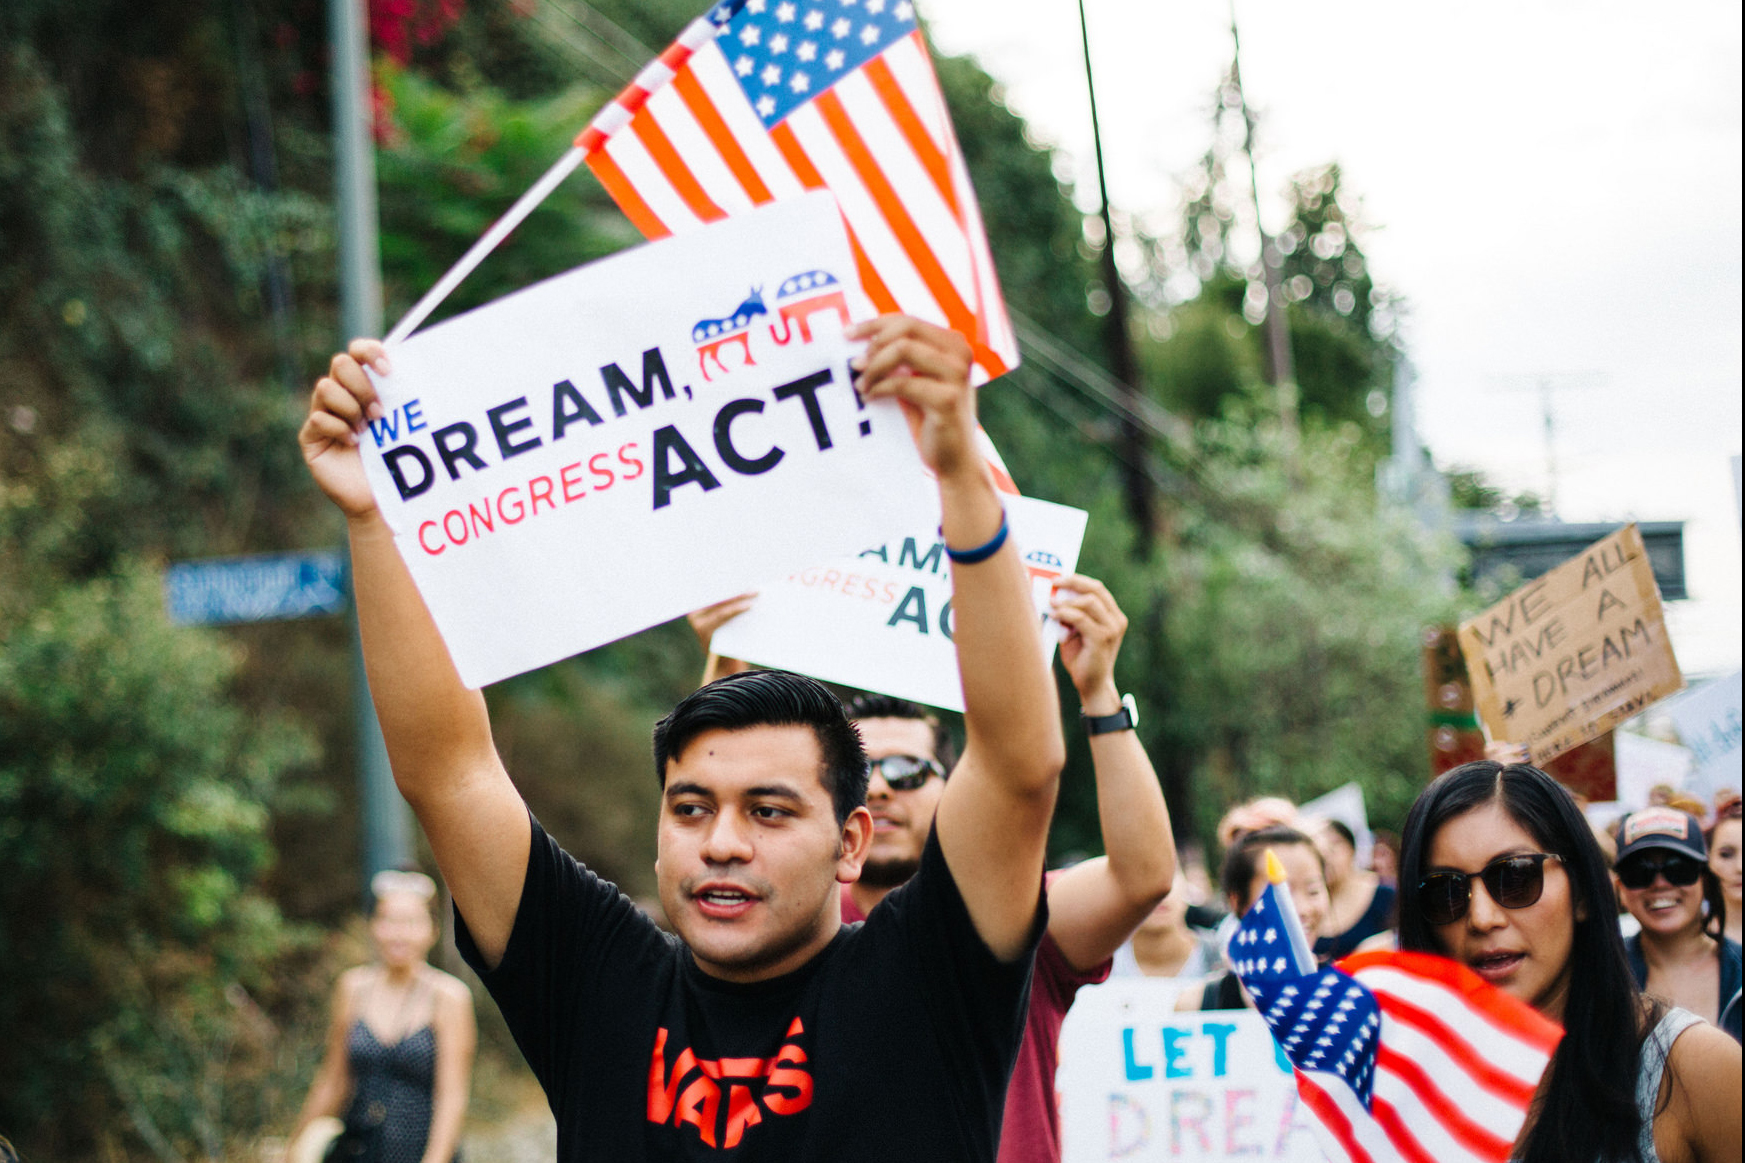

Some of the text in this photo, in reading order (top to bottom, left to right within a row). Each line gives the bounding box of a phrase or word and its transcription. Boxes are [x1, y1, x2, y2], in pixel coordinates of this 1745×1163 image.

[368, 400, 428, 447] WE
[381, 347, 693, 502] DREAM,
[418, 442, 645, 556] CONGRESS
[1473, 543, 1639, 648] WE ALL
[1483, 588, 1627, 686] HAVE A
[1532, 617, 1652, 709] DREAM
[1123, 1023, 1237, 1081] LET
